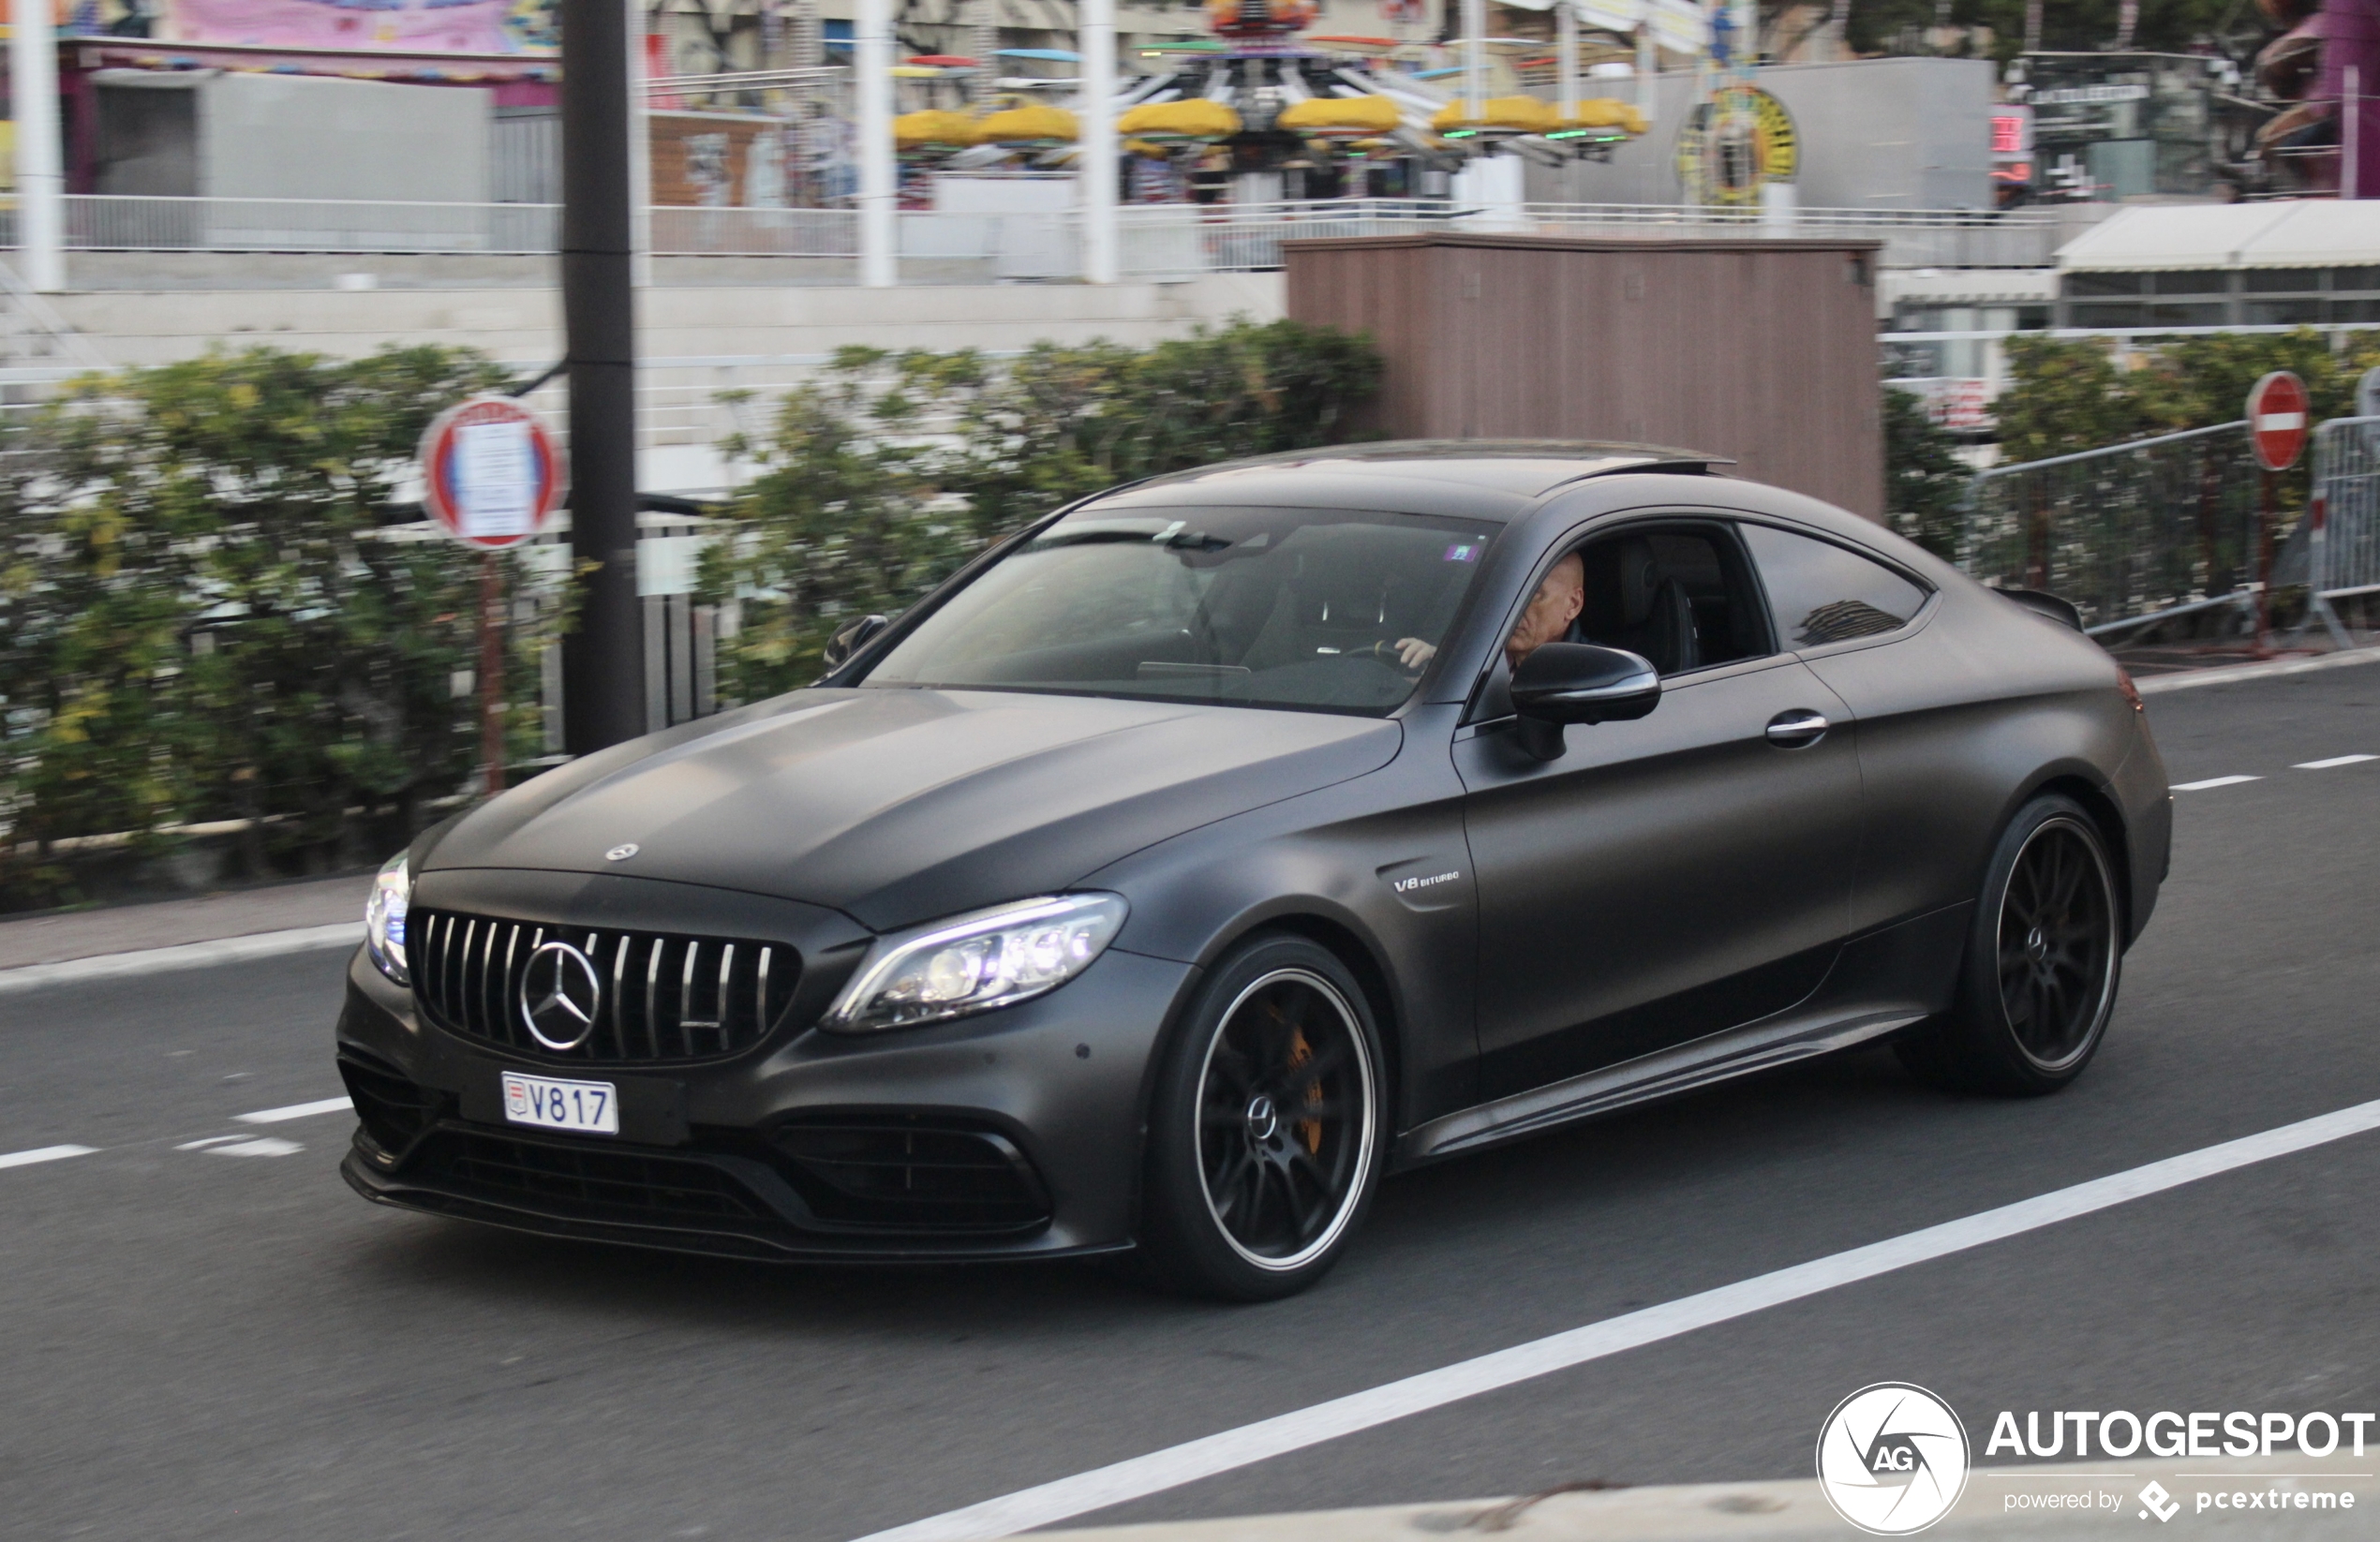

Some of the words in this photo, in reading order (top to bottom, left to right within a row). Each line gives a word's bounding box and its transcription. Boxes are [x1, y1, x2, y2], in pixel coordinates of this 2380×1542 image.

[1394, 877, 1419, 893] V8
[1420, 870, 1459, 887] BITURBO
[528, 1083, 607, 1125] V817
